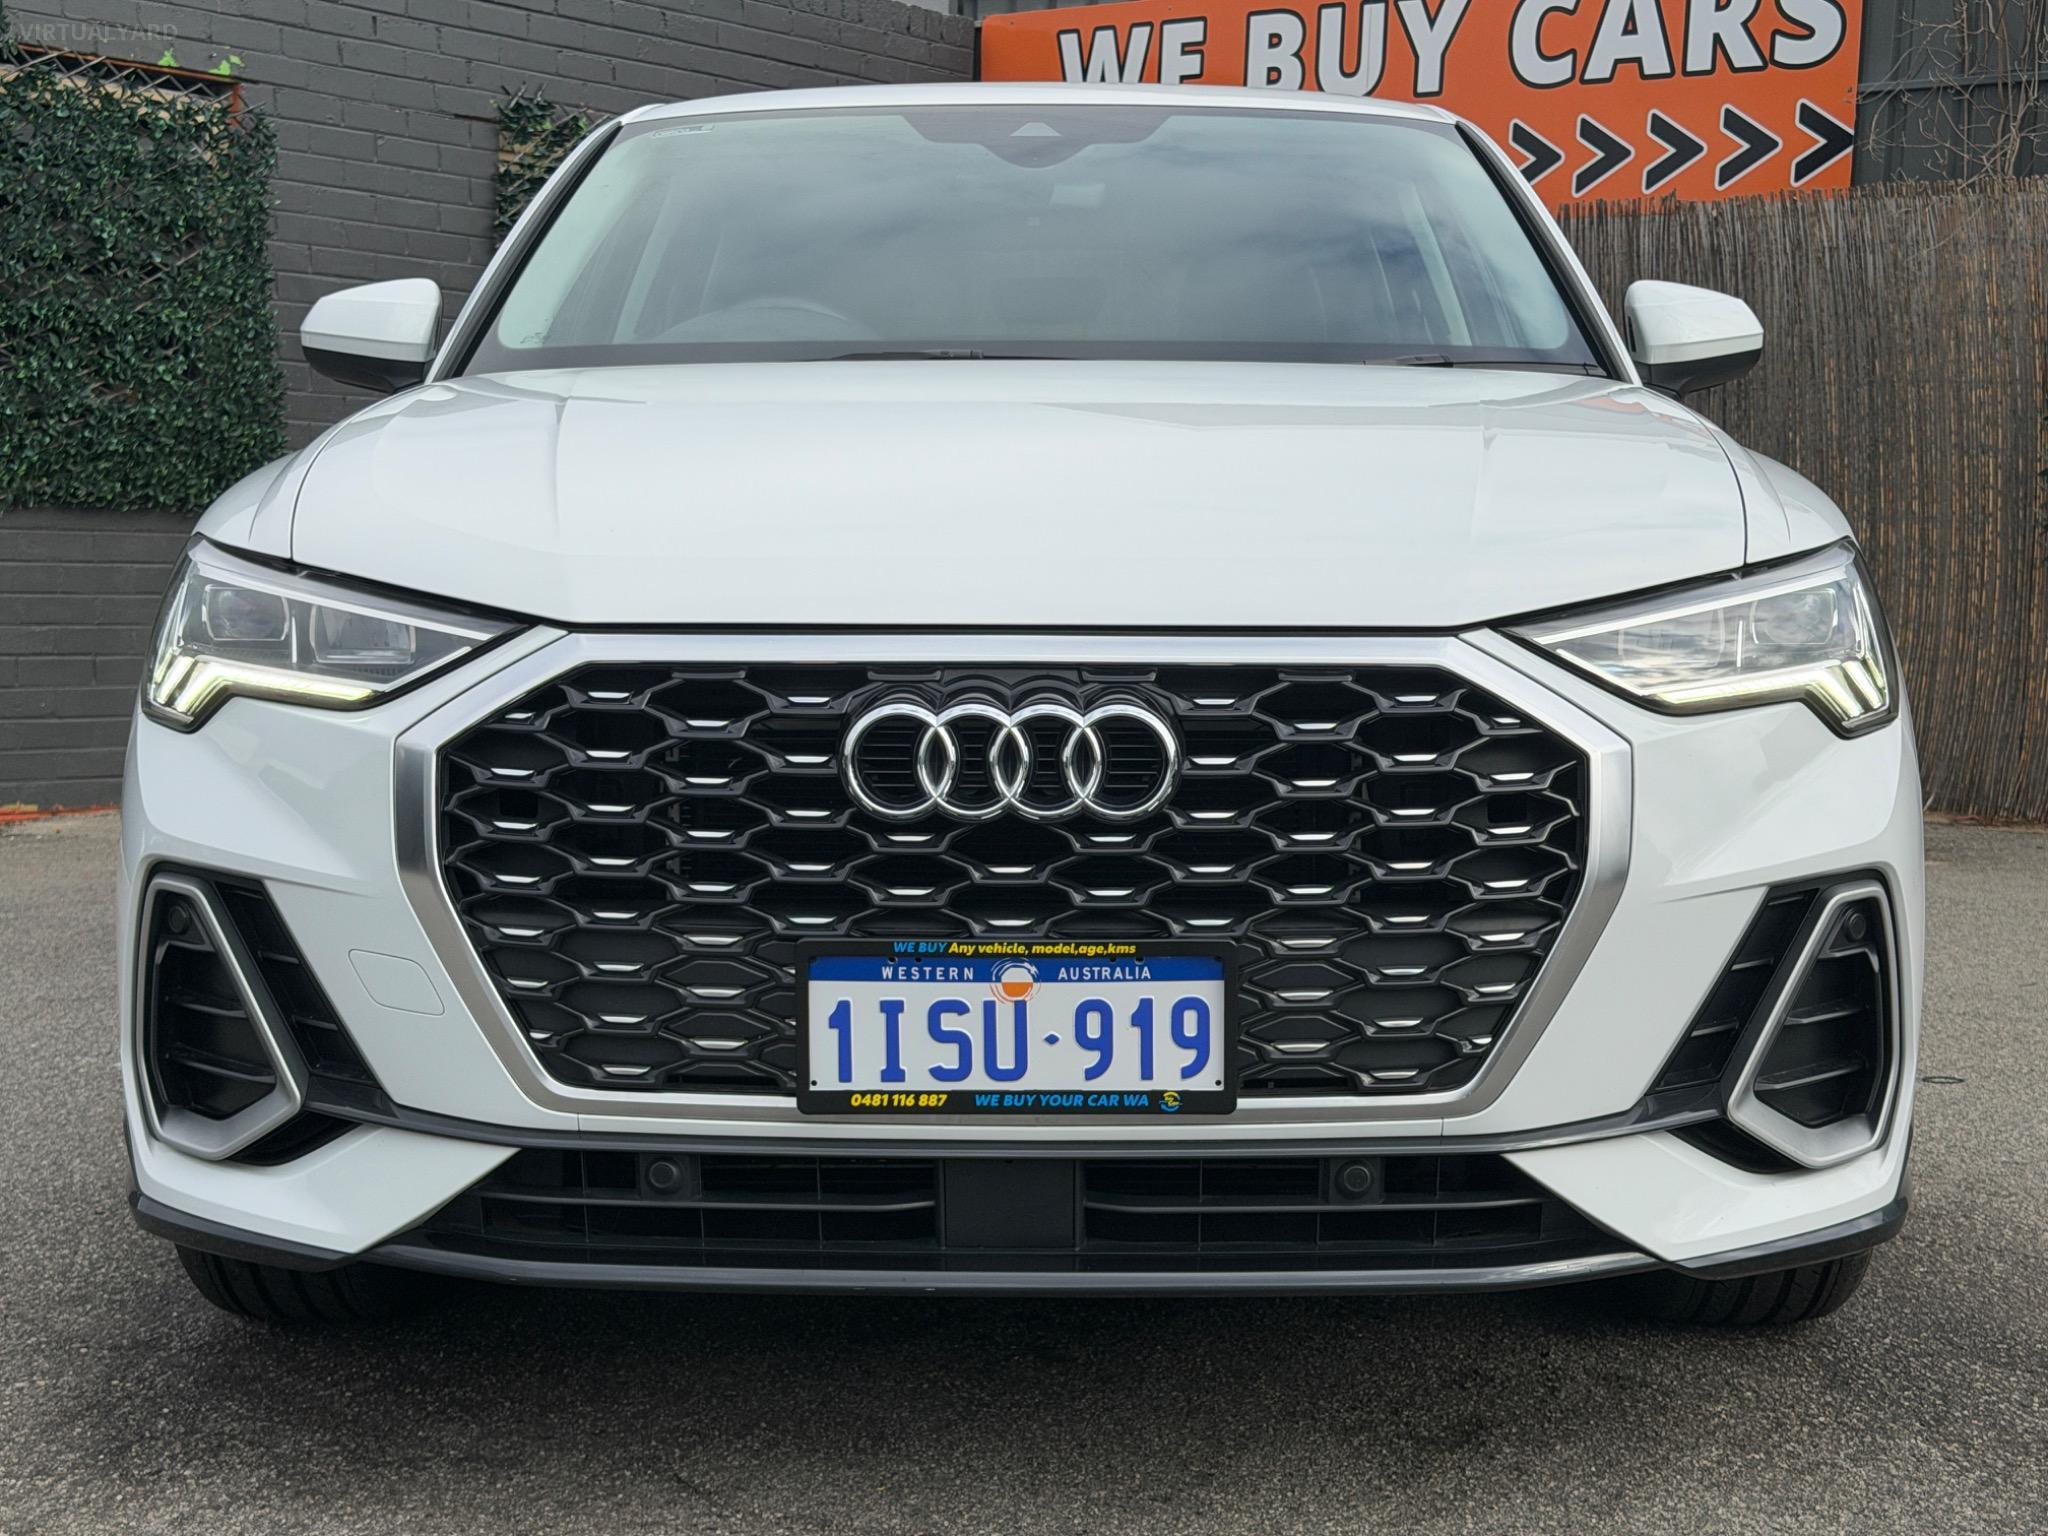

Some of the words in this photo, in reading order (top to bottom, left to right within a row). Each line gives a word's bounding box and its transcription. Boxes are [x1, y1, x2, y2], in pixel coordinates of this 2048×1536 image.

[1057, 16, 1207, 84] WE
[1244, 0, 1470, 98] BUY
[1508, 0, 1848, 89] CARS
[893, 942, 915, 953] WE
[918, 942, 947, 953] BUY
[948, 942, 976, 956] Any
[978, 942, 1029, 955] vehicle,
[881, 965, 974, 981] WESTERN
[1057, 965, 1152, 981] AUSTRALIA
[851, 1093, 889, 1107] 0481
[892, 1093, 915, 1107] 116
[918, 1093, 948, 1107] 887
[975, 1094, 1000, 1107] WE
[1003, 1094, 1036, 1107] BUY
[1040, 1094, 1083, 1107] YOUR
[1087, 1094, 1119, 1107] CAR
[1123, 1094, 1149, 1107] WA
